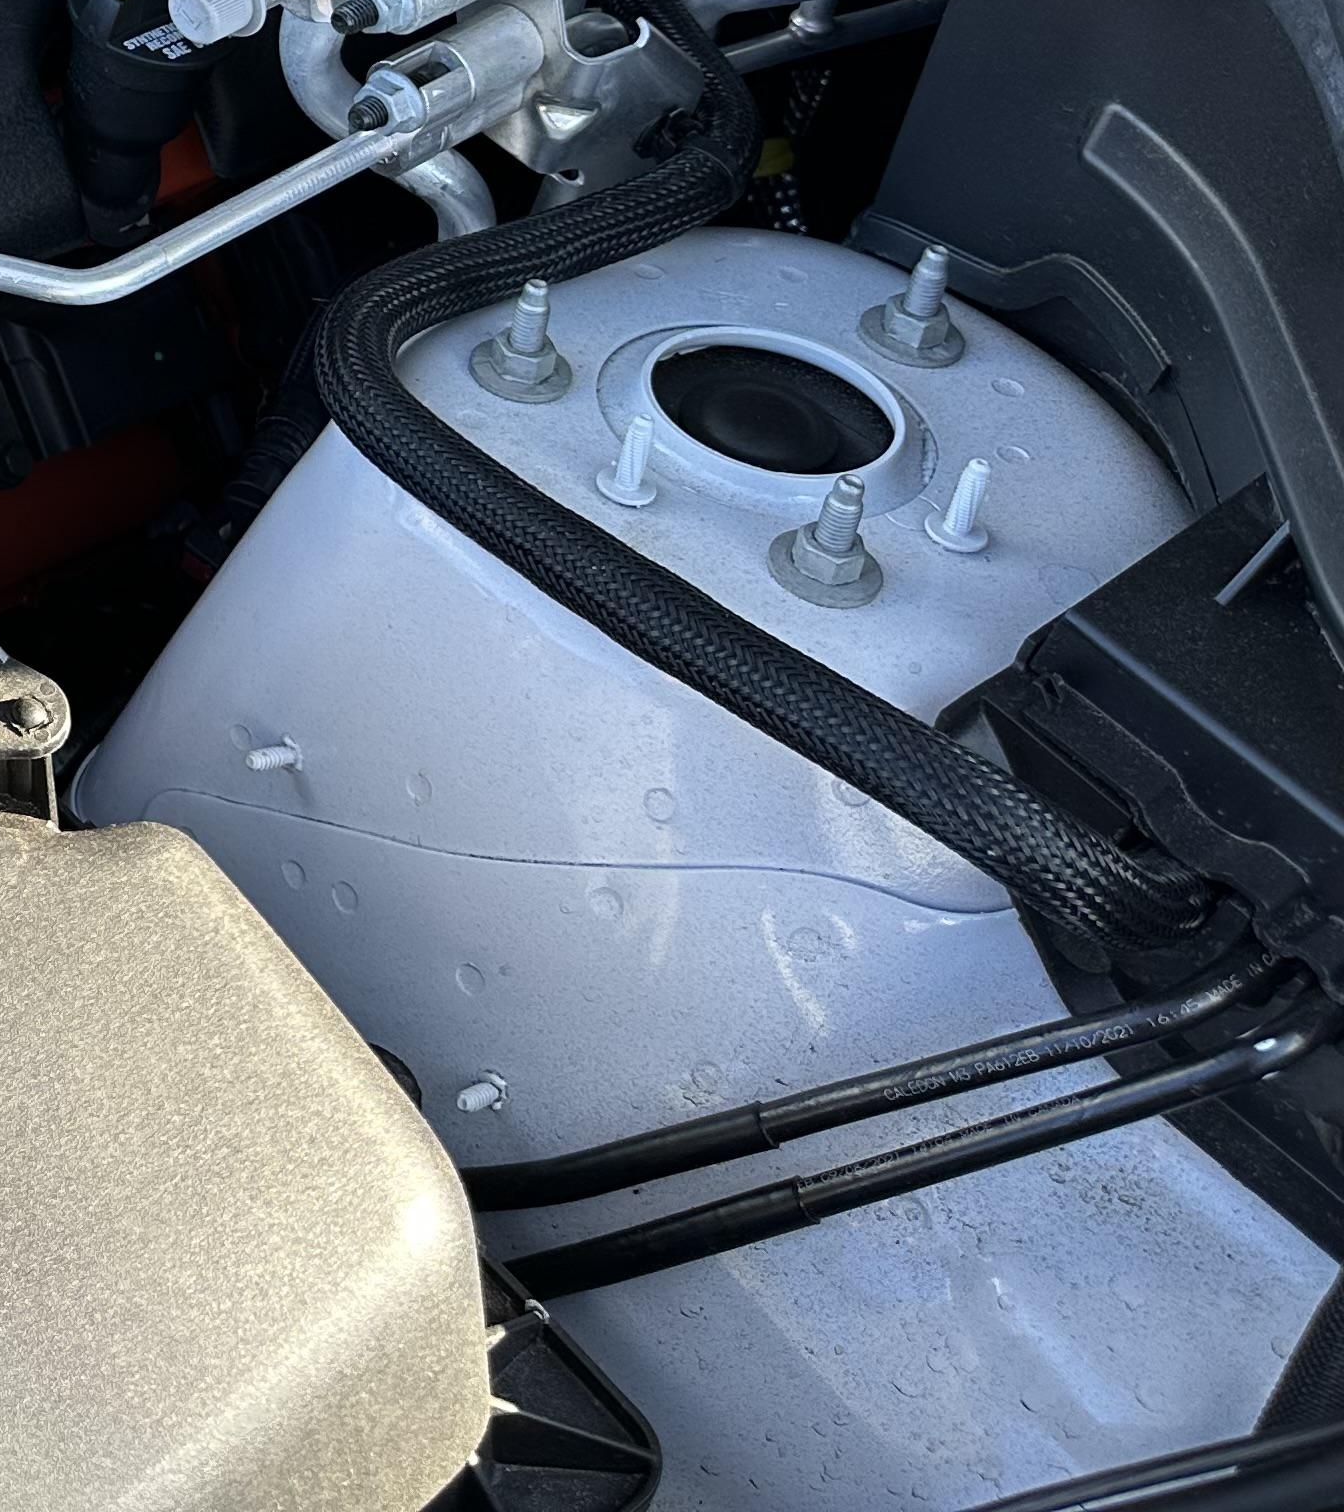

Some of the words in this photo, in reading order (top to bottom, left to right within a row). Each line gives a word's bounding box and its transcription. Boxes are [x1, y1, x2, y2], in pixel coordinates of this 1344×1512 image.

[162, 41, 193, 60] SAE
[883, 1075, 946, 1103] CALEDON
[974, 1047, 1041, 1078] PA612EB
[1046, 1023, 1134, 1057] 11/10/2021
[1146, 997, 1200, 1027] 16:45
[1207, 974, 1244, 1002] MADE
